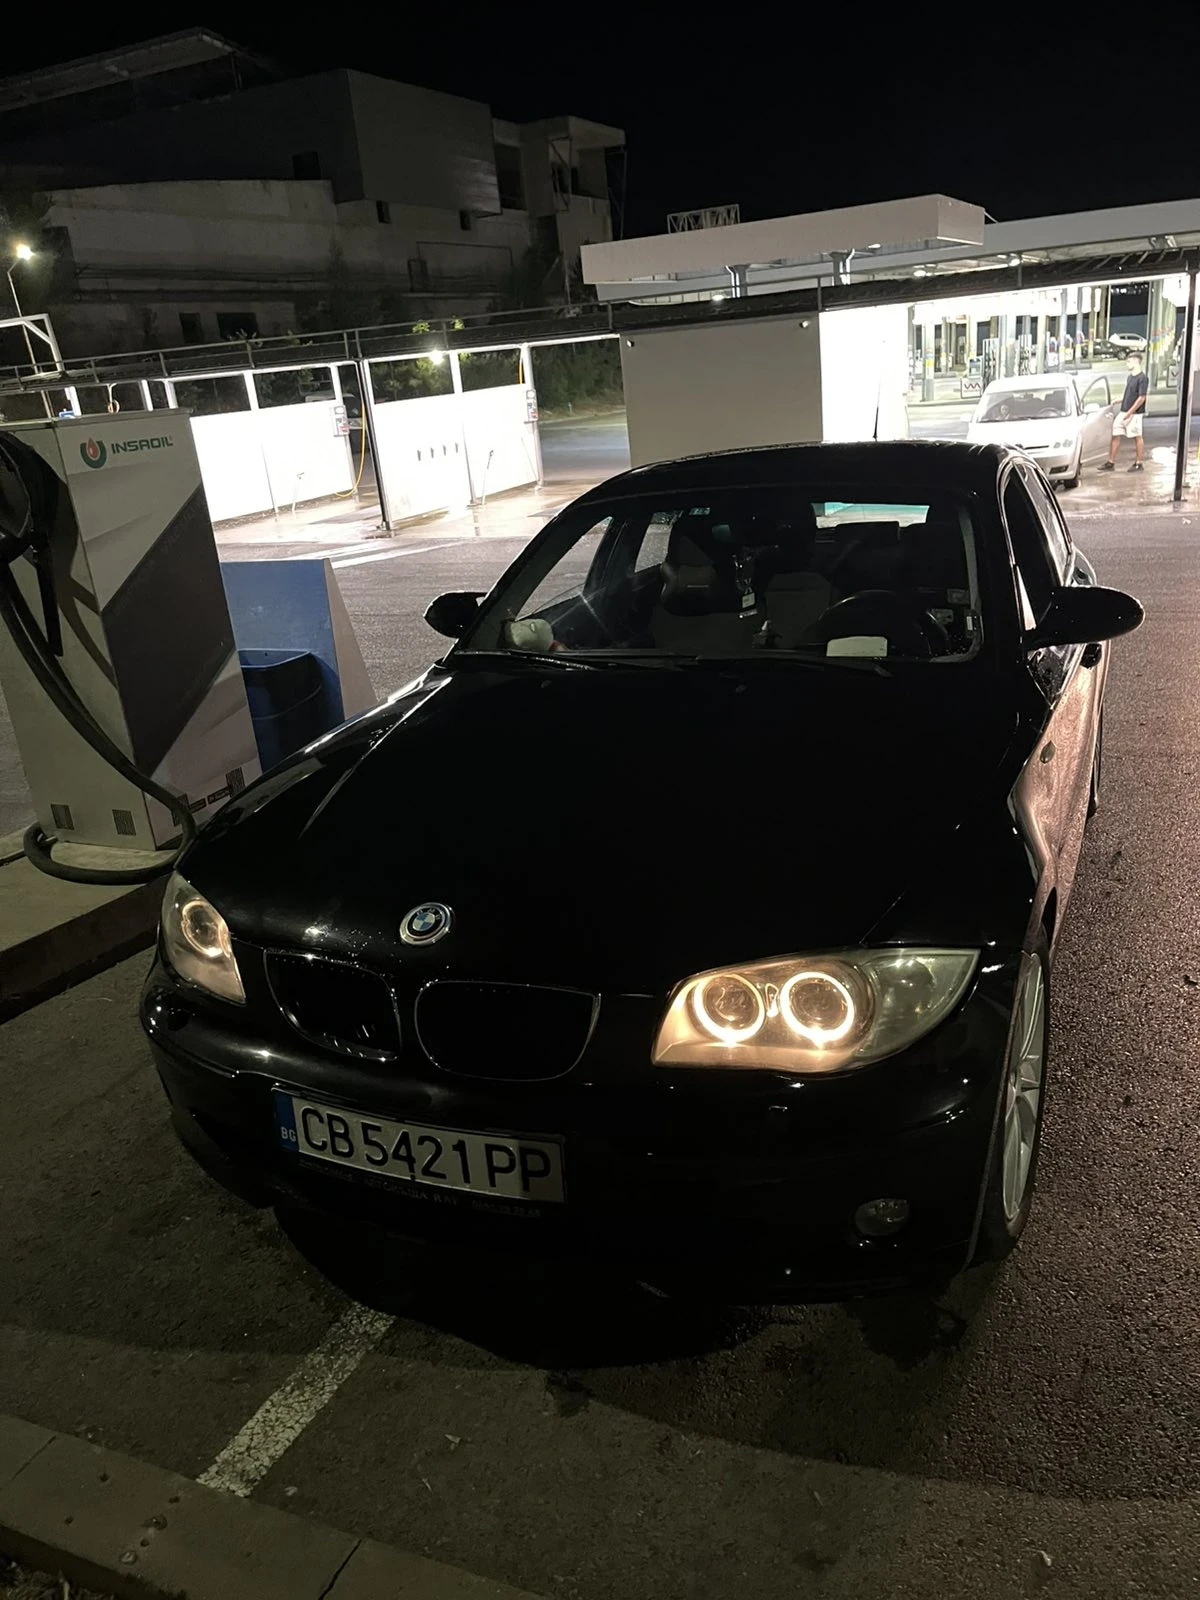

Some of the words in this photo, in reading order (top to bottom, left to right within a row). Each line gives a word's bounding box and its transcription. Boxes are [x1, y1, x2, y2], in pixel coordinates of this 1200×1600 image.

[111, 436, 173, 454] INSAOIL
[280, 1126, 297, 1143] BG
[301, 1107, 355, 1158] CB
[360, 1122, 471, 1184] 5421
[484, 1142, 552, 1193] PP
